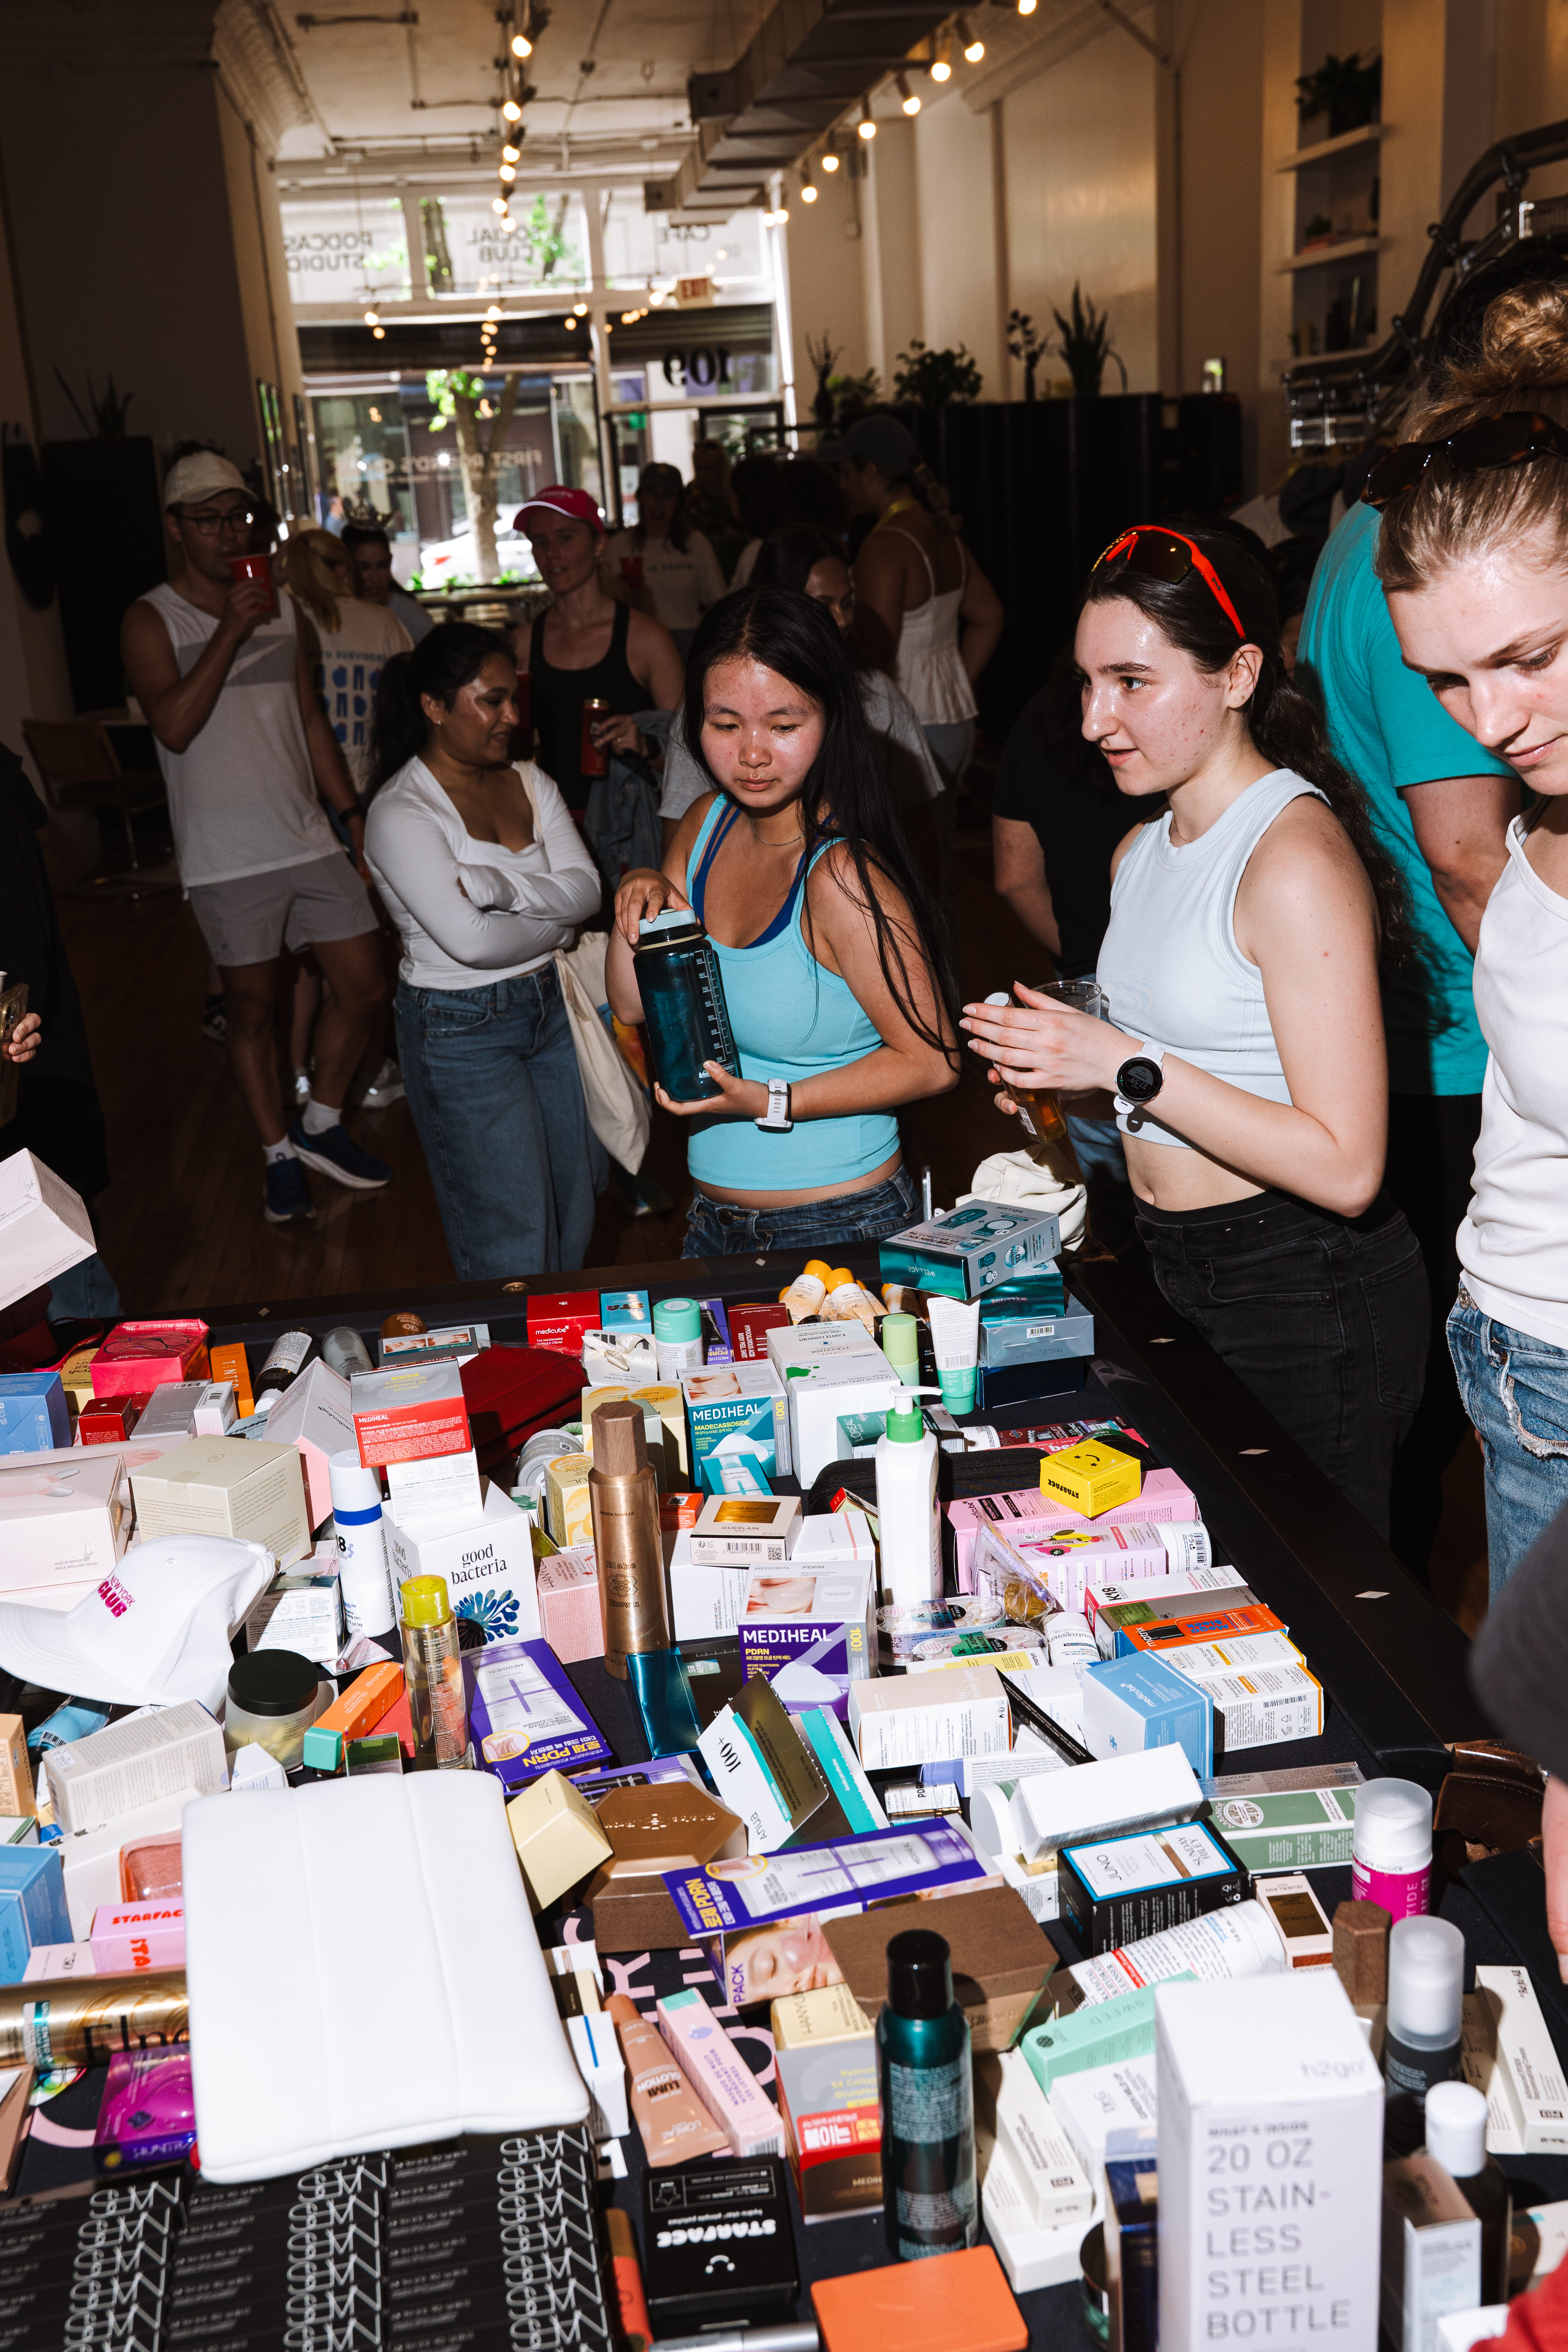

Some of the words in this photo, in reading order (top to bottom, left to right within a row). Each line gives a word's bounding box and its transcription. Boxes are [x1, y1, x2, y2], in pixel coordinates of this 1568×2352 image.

[1131, 1078, 1148, 1089] 27:59
[907, 1265, 936, 1277] WELLAGE
[744, 1324, 753, 1349] HYPOCHLOROUS
[358, 1414, 389, 1423] MEDIHEAL
[693, 1403, 762, 1421] MEDIHEAL
[775, 1400, 785, 1417] 100
[694, 1420, 750, 1430] MADECASSOSIDE
[1048, 1479, 1079, 1499] STARFACE
[394, 1539, 406, 1561] good
[462, 1544, 494, 1569] good
[452, 1558, 508, 1585] bacteria
[605, 1561, 636, 1569] Blake
[98, 1581, 127, 1617] CLUB
[109, 1575, 122, 1590] NEW
[118, 1584, 136, 1606] YORK
[1102, 1587, 1116, 1601] K18
[609, 1599, 640, 1608] Brown
[939, 1602, 951, 1624] MAXIMALIST
[743, 1629, 832, 1644] MEDIHEAL
[850, 1627, 862, 1647] 100
[1135, 1627, 1157, 1647] matrix
[1191, 1624, 1229, 1633] Mega
[486, 1663, 523, 1674] MEDIHEAL
[1030, 1653, 1040, 1666] manyo
[1171, 1654, 1187, 1668] KIEHL'S
[365, 1662, 390, 1688] patchology
[873, 1694, 882, 1710] MATILDA
[1125, 1684, 1156, 1708] medicube
[574, 1740, 601, 1753] 로제
[523, 1748, 571, 1767] PDRN
[1215, 1801, 1236, 1829] AMANDE
[750, 1811, 768, 1840] Anua
[1176, 1837, 1204, 1867] SUNDAY
[1190, 1838, 1210, 1860] RILEY
[1097, 1855, 1122, 1882] JUNO
[1376, 1863, 1403, 1872] CHOICE
[1265, 1885, 1302, 1893] GUERLAIN
[112, 1909, 184, 1925] STARFAC
[733, 1964, 745, 2004] PACK
[1091, 1999, 1145, 2025] SWEED
[647, 2081, 680, 2098] LUMI
[803, 2125, 852, 2149] 붙이는
[1207, 2142, 1251, 2174] 20
[1265, 2138, 1314, 2171] OZ
[1207, 2180, 1332, 2217] STAIN-
[656, 2219, 777, 2248] STARFACE
[1206, 2224, 1303, 2259] LESS
[1207, 2264, 1325, 2300] STEEL
[1207, 2299, 1352, 2340] BOTTLE
